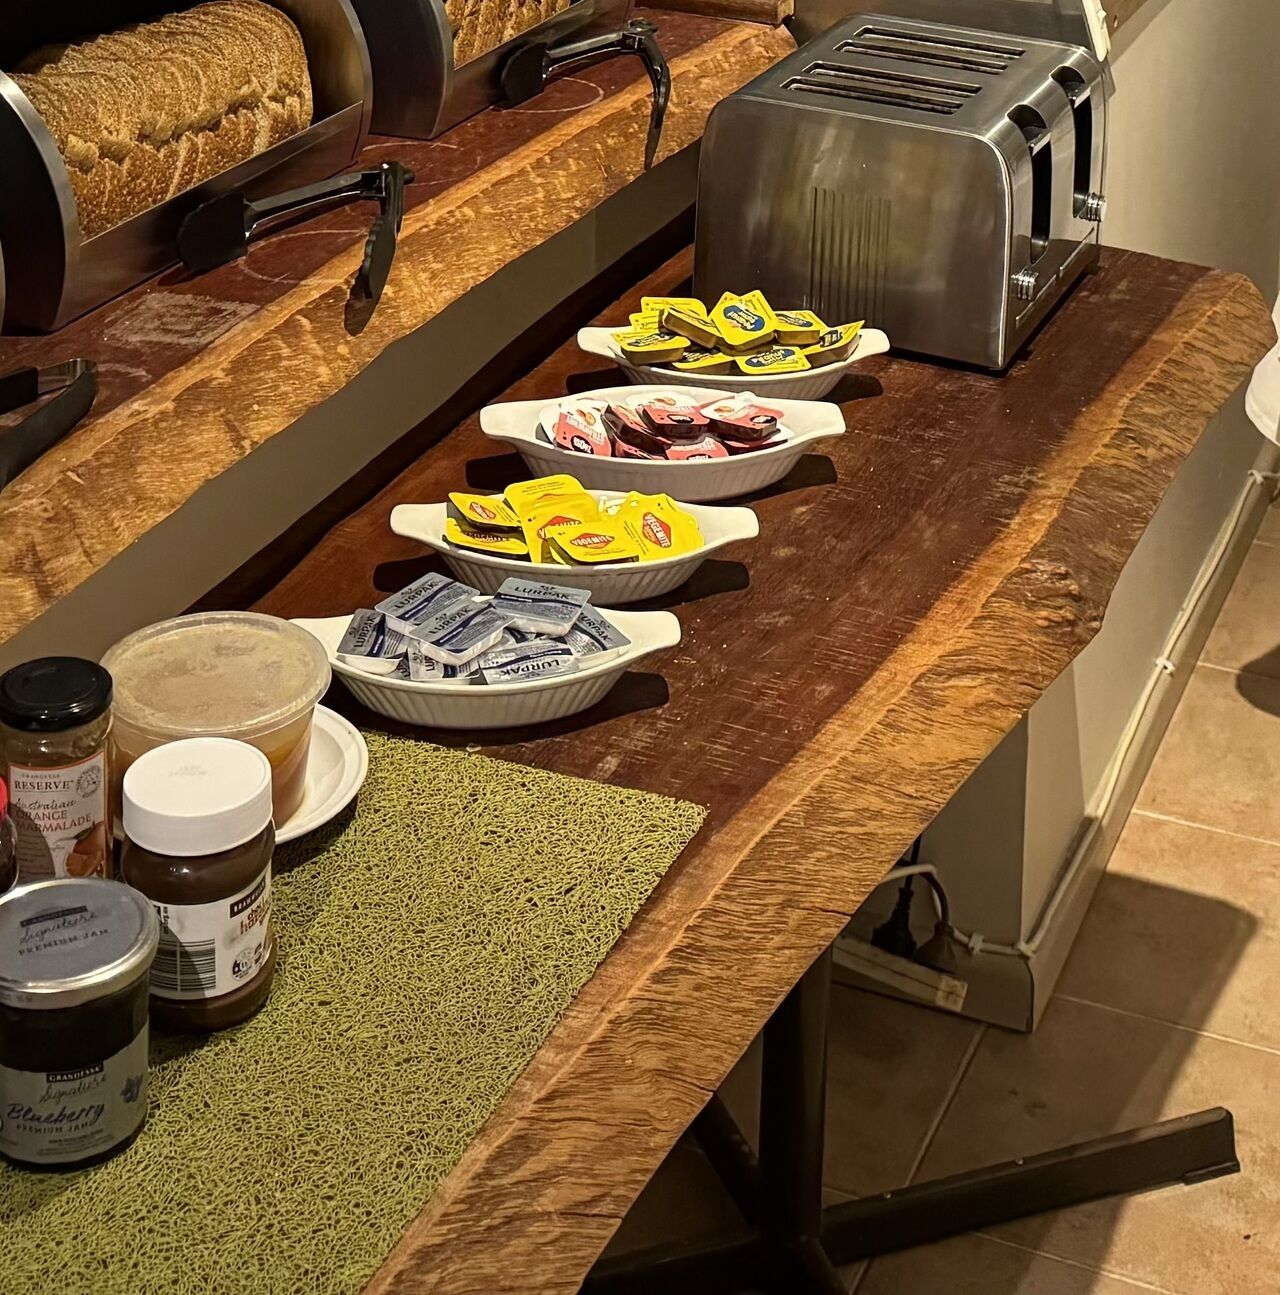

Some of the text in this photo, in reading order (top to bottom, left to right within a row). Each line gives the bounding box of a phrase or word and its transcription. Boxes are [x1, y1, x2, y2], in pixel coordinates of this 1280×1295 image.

[644, 514, 671, 548] VEGEMITE
[394, 582, 435, 610] LURPAK
[514, 586, 570, 600] LURPAK
[428, 607, 470, 635] LURPAK
[353, 615, 376, 648] LURPAK
[500, 659, 561, 677] LURPAK
[14, 780, 68, 791] RESERVE
[16, 809, 68, 821] ORANGE
[22, 814, 92, 833] MARMALADE
[18, 928, 109, 956] PREMIUM JAM
[49, 1066, 100, 1082] GRANDESSA
[7, 1103, 105, 1127] Blueberry
[16, 1122, 89, 1134] PREMIUM JAM
